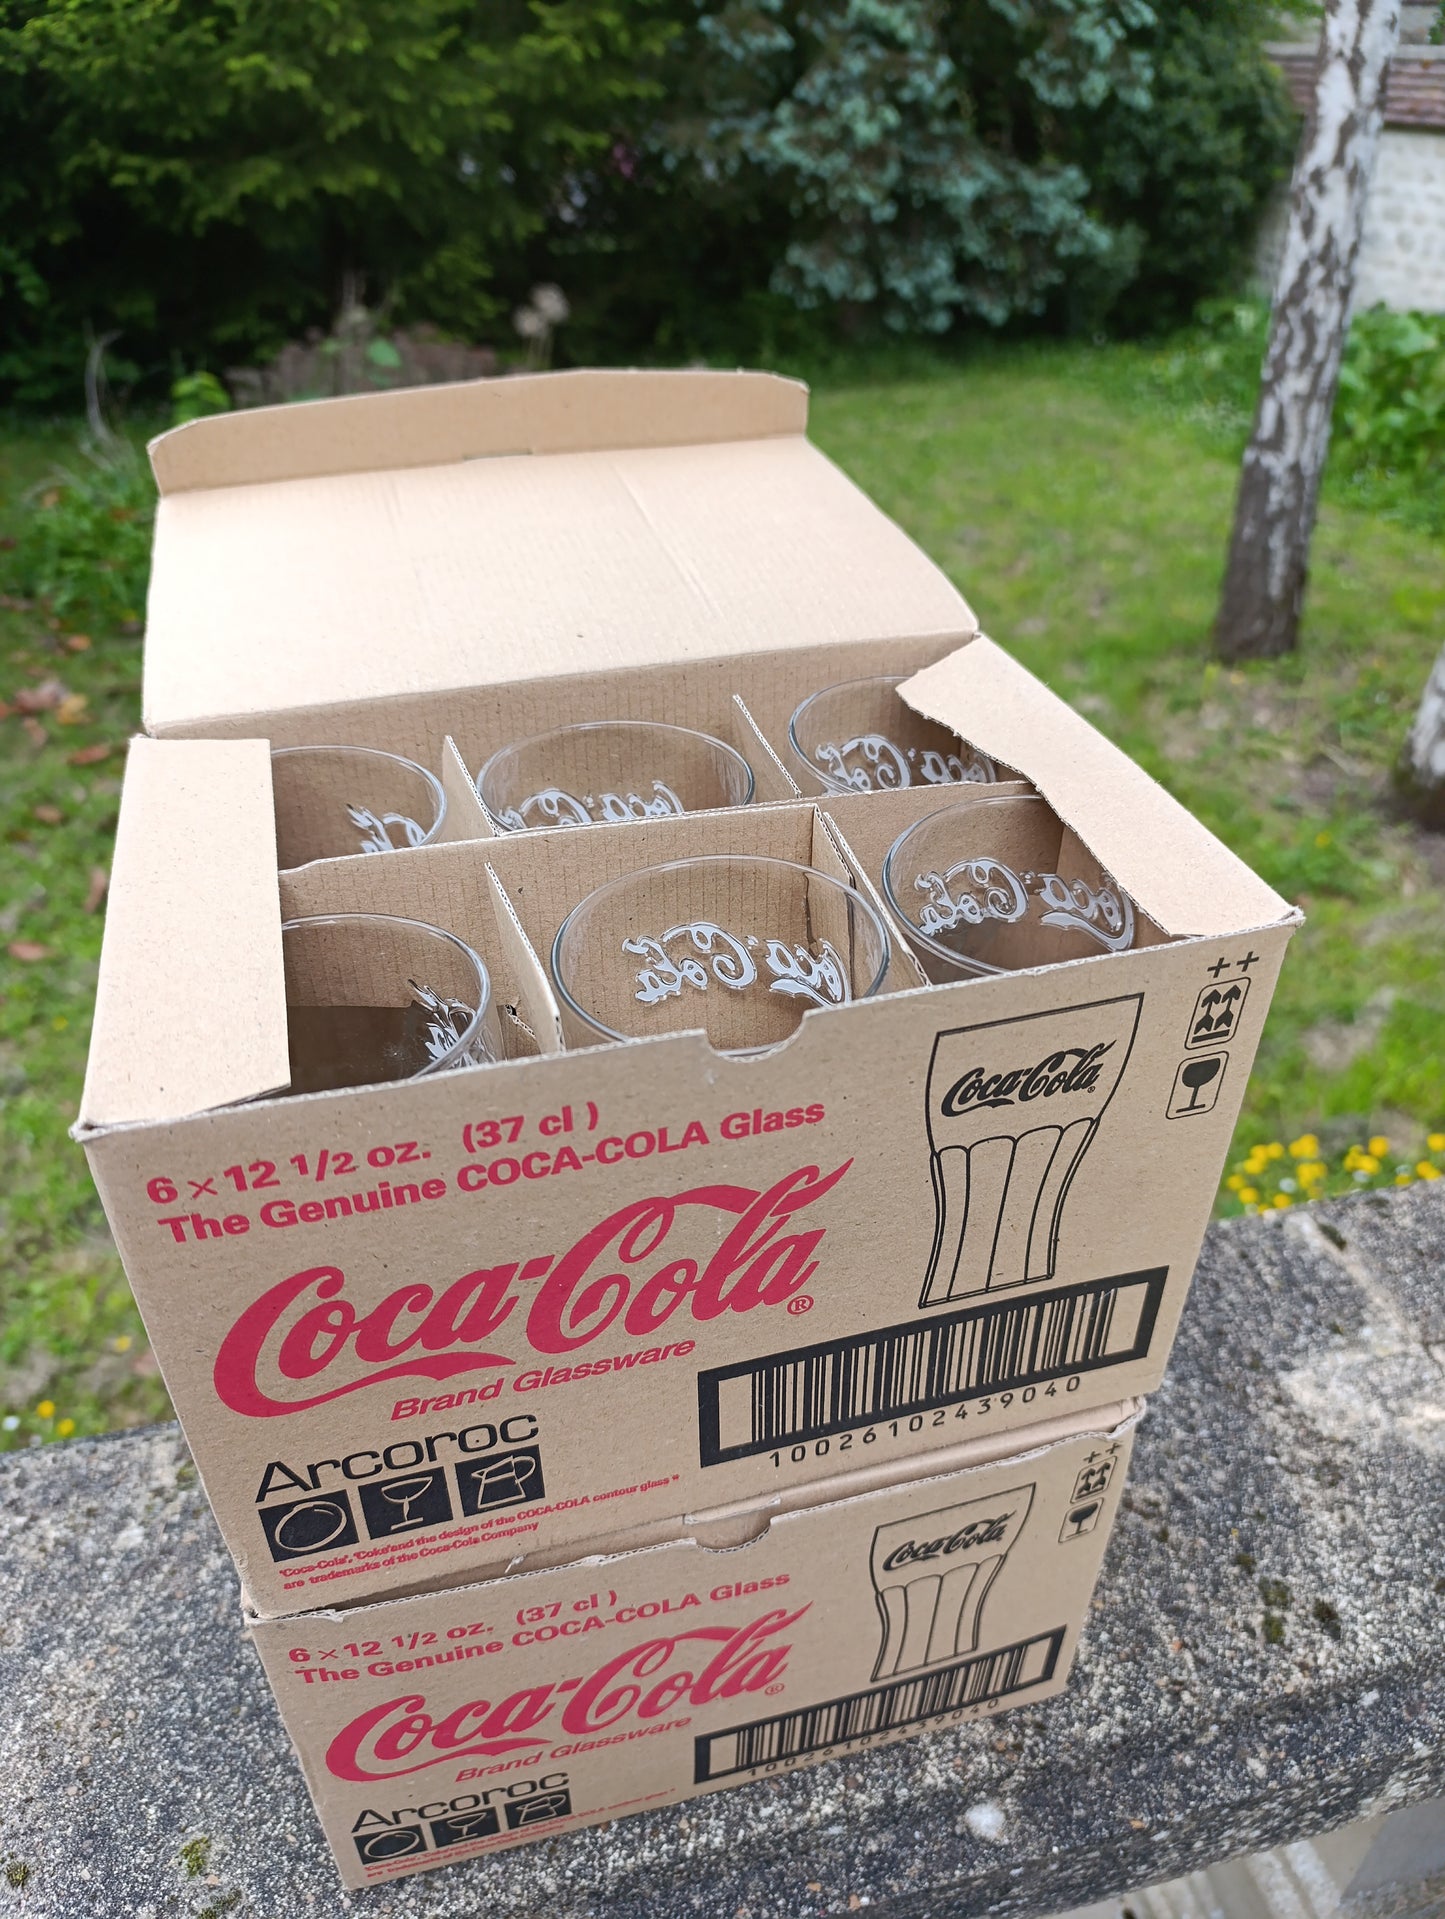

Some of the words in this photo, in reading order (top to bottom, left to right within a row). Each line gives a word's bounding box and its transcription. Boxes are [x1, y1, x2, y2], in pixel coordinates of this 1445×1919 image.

[146, 1177, 178, 1204] 6
[223, 1161, 281, 1192] 12
[290, 1149, 356, 1182] 1/2
[366, 1141, 431, 1168] oz.
[157, 1213, 250, 1243] The
[259, 1178, 447, 1228] Genuine
[456, 1121, 710, 1192] COCA-COLA
[719, 1103, 825, 1140] Glass
[213, 1157, 854, 1417] Coca-Cola
[390, 1378, 504, 1421] Brand
[512, 1338, 697, 1392] Glassware
[256, 1414, 539, 1503] Arcoroc
[767, 1376, 1081, 1468] 10026102439040
[438, 1522, 479, 1541] design
[480, 1517, 495, 1530] of
[517, 1494, 590, 1521] COCA-COLA
[593, 1484, 639, 1503] contour
[640, 1477, 670, 1493] glass
[283, 1581, 305, 1590] are
[309, 1560, 381, 1584] trademarks
[420, 1536, 481, 1558] Coca-Cola
[480, 1522, 540, 1543] Company
[289, 1648, 311, 1663] 6
[343, 1641, 383, 1657] 12
[392, 1632, 438, 1650] 1/2
[446, 1622, 494, 1639] oz.
[295, 1668, 360, 1684] The
[367, 1640, 504, 1677] Genuine
[511, 1593, 702, 1646] COCA-COLA
[710, 1573, 790, 1601] Glass
[325, 1600, 813, 1782] Coca-Cola
[455, 1750, 541, 1783] Brand
[550, 1717, 692, 1759] Glassware
[351, 1772, 570, 1833] Arcoroc
